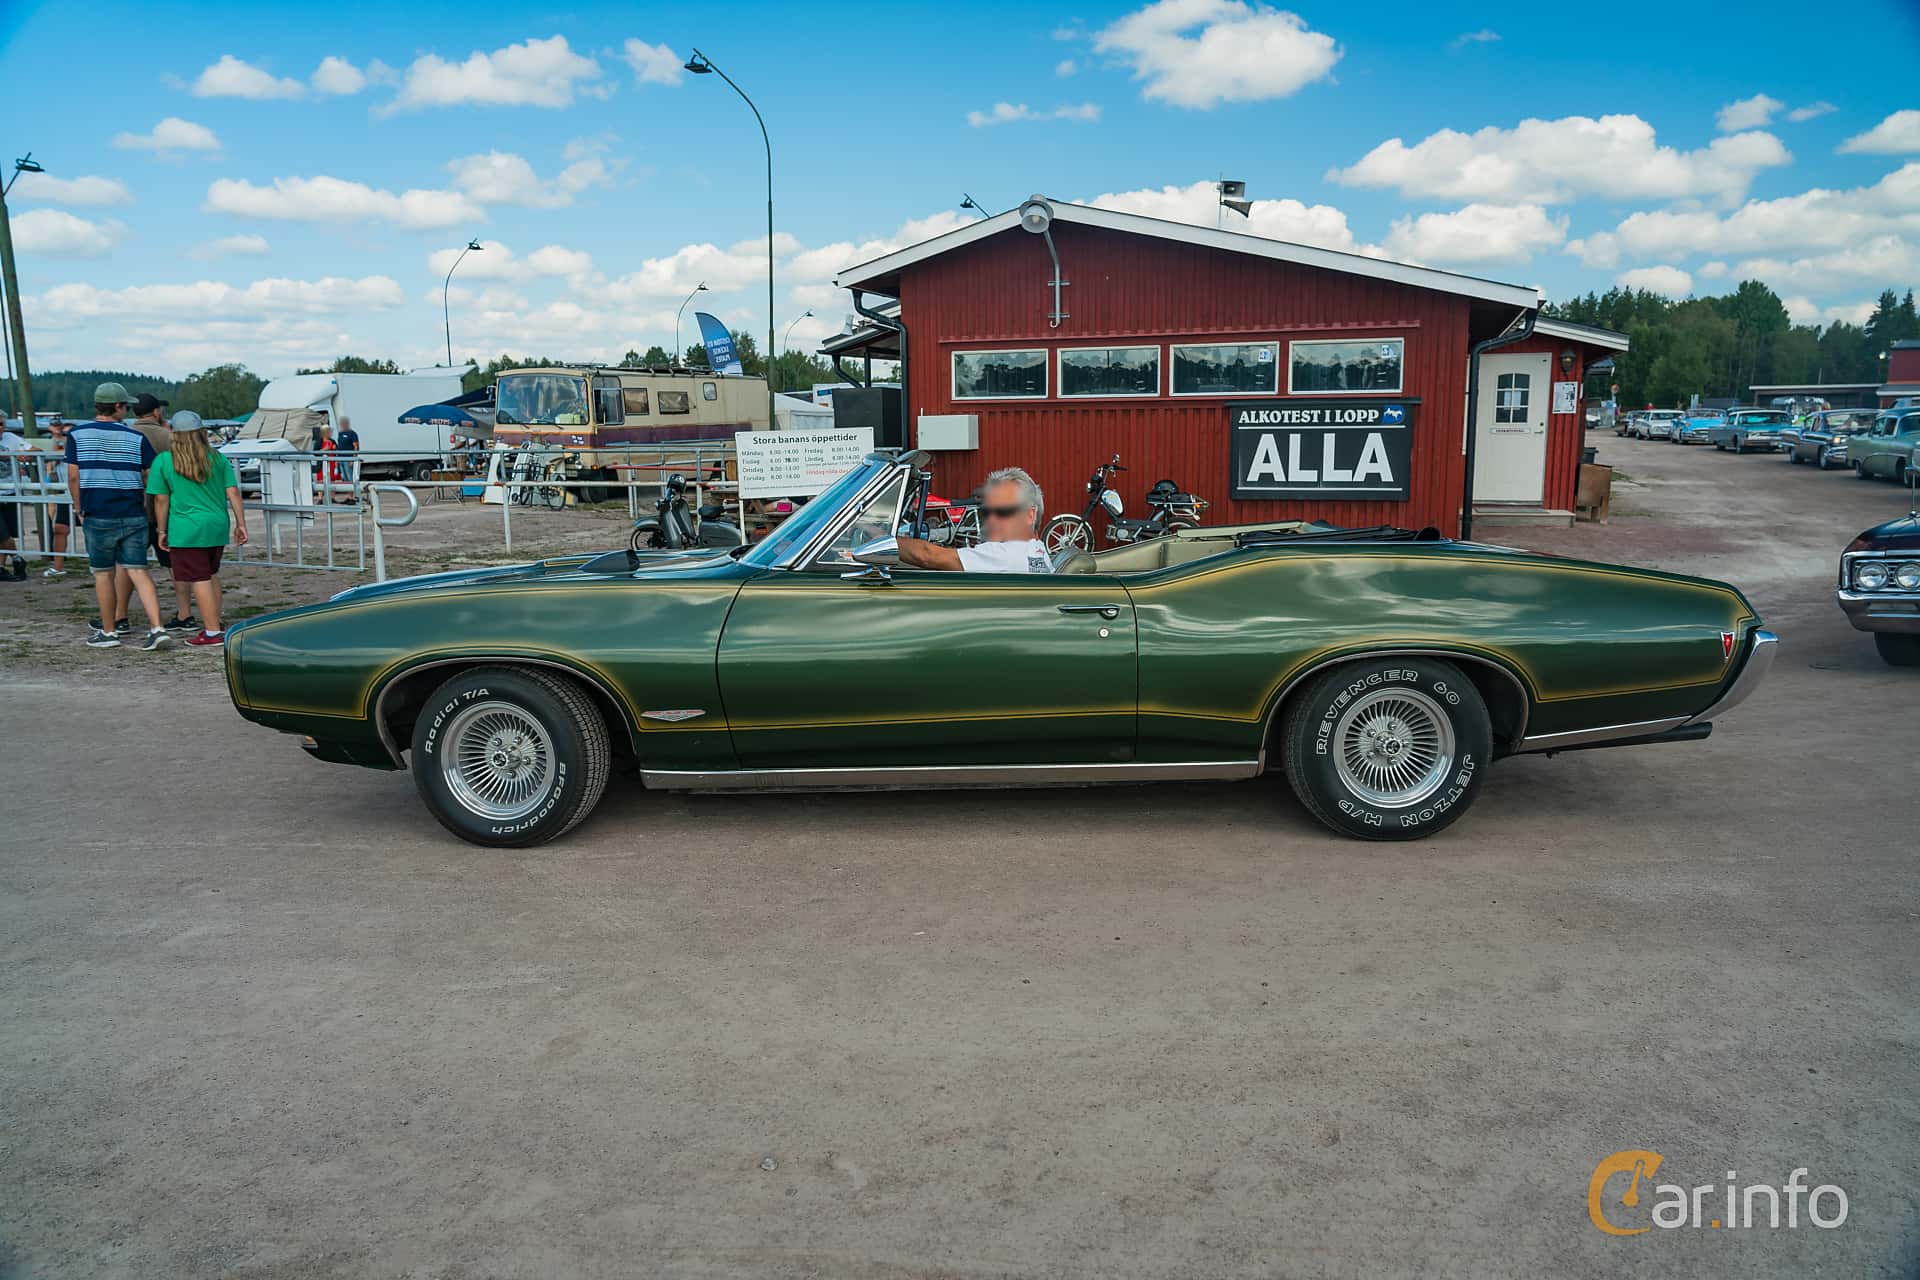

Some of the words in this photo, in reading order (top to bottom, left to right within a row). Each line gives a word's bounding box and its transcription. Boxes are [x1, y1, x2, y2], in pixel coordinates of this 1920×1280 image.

[753, 436, 776, 444] Stora
[778, 435, 810, 444] banans
[812, 434, 857, 444] öppettider
[1238, 409, 1320, 424] ALKOTEST
[1325, 410, 1331, 423] I
[1334, 409, 1379, 423] LOPP
[1246, 432, 1394, 482] ALLA
[424, 698, 459, 754] Radial
[462, 688, 490, 700] T/A
[1316, 670, 1419, 755] REVENGER
[1433, 682, 1460, 704] 60
[492, 762, 566, 834] BFGoodrich
[1400, 754, 1475, 827] JETZON
